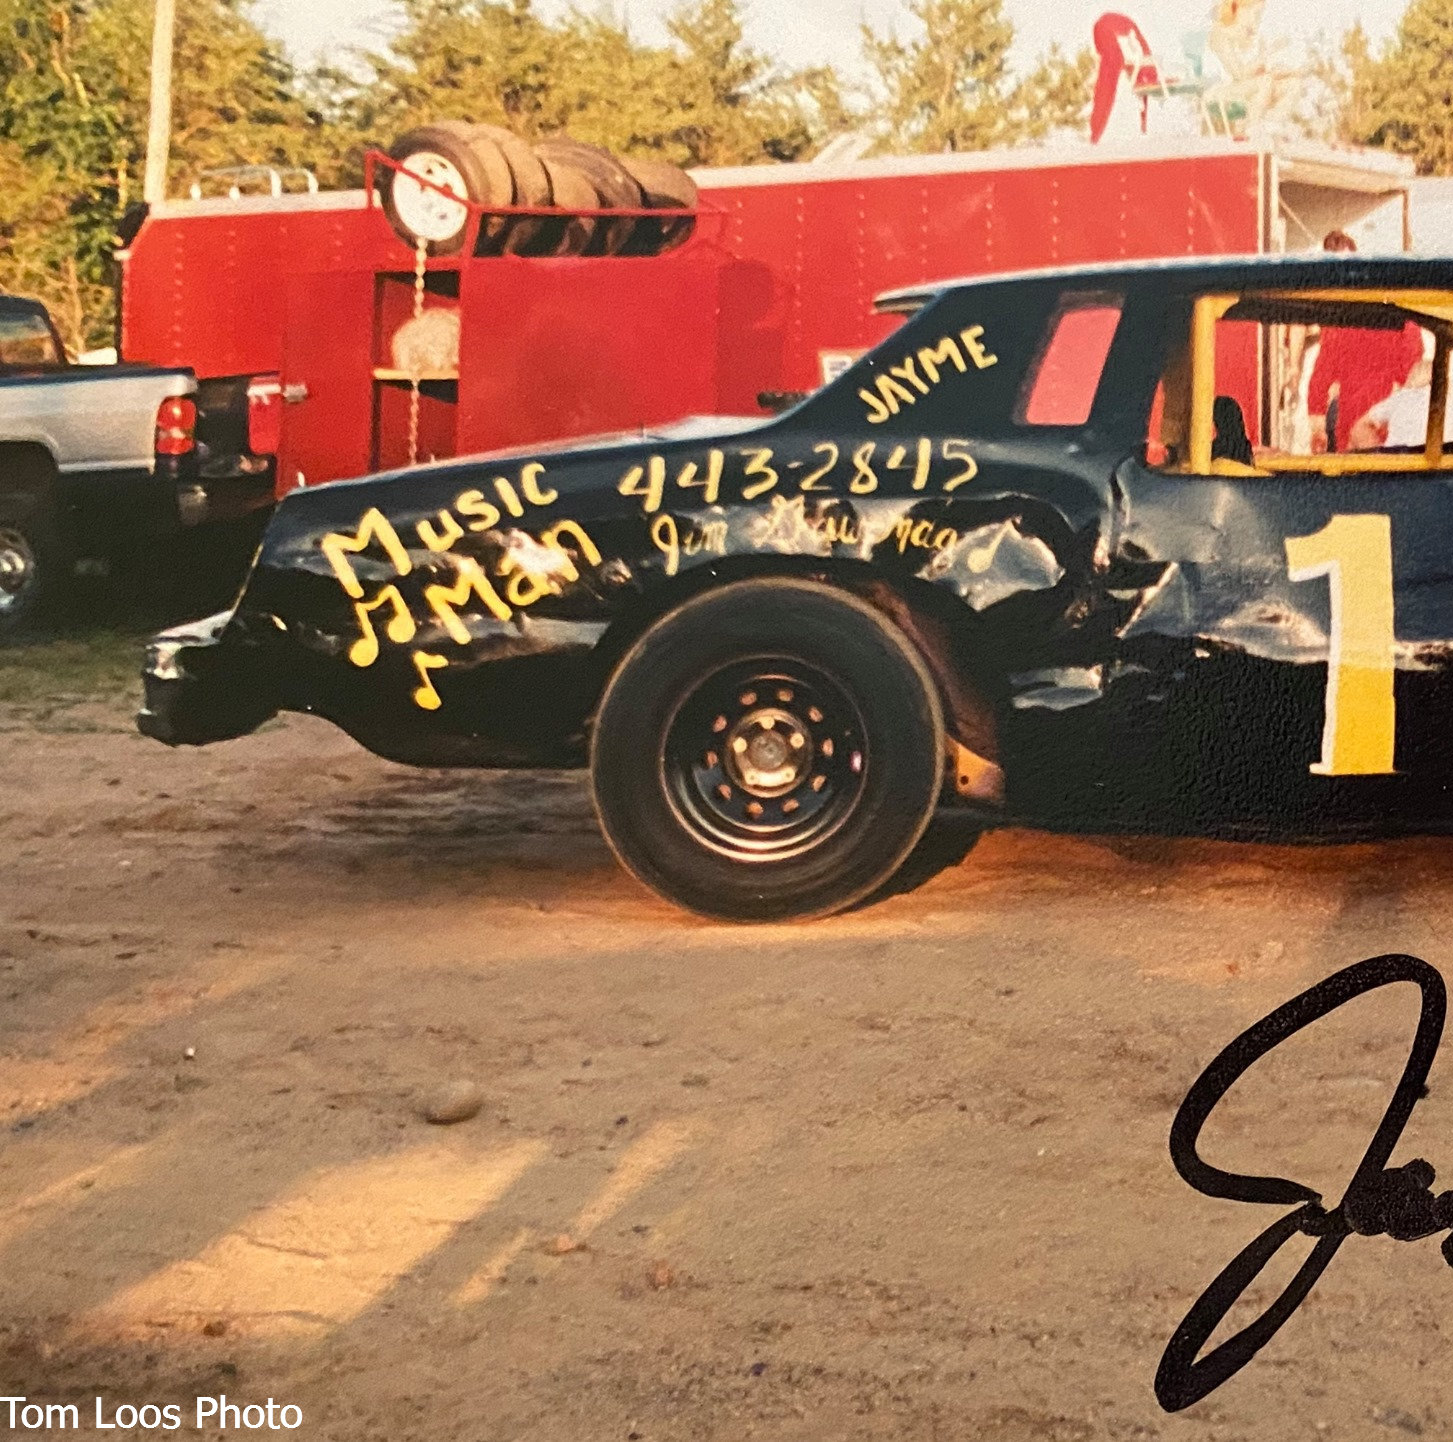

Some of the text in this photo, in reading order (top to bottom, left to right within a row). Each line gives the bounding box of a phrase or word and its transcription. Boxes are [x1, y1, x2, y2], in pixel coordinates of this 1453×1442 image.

[858, 324, 998, 424] JAYME
[618, 437, 979, 513] 443-2845
[424, 519, 602, 645] Man
